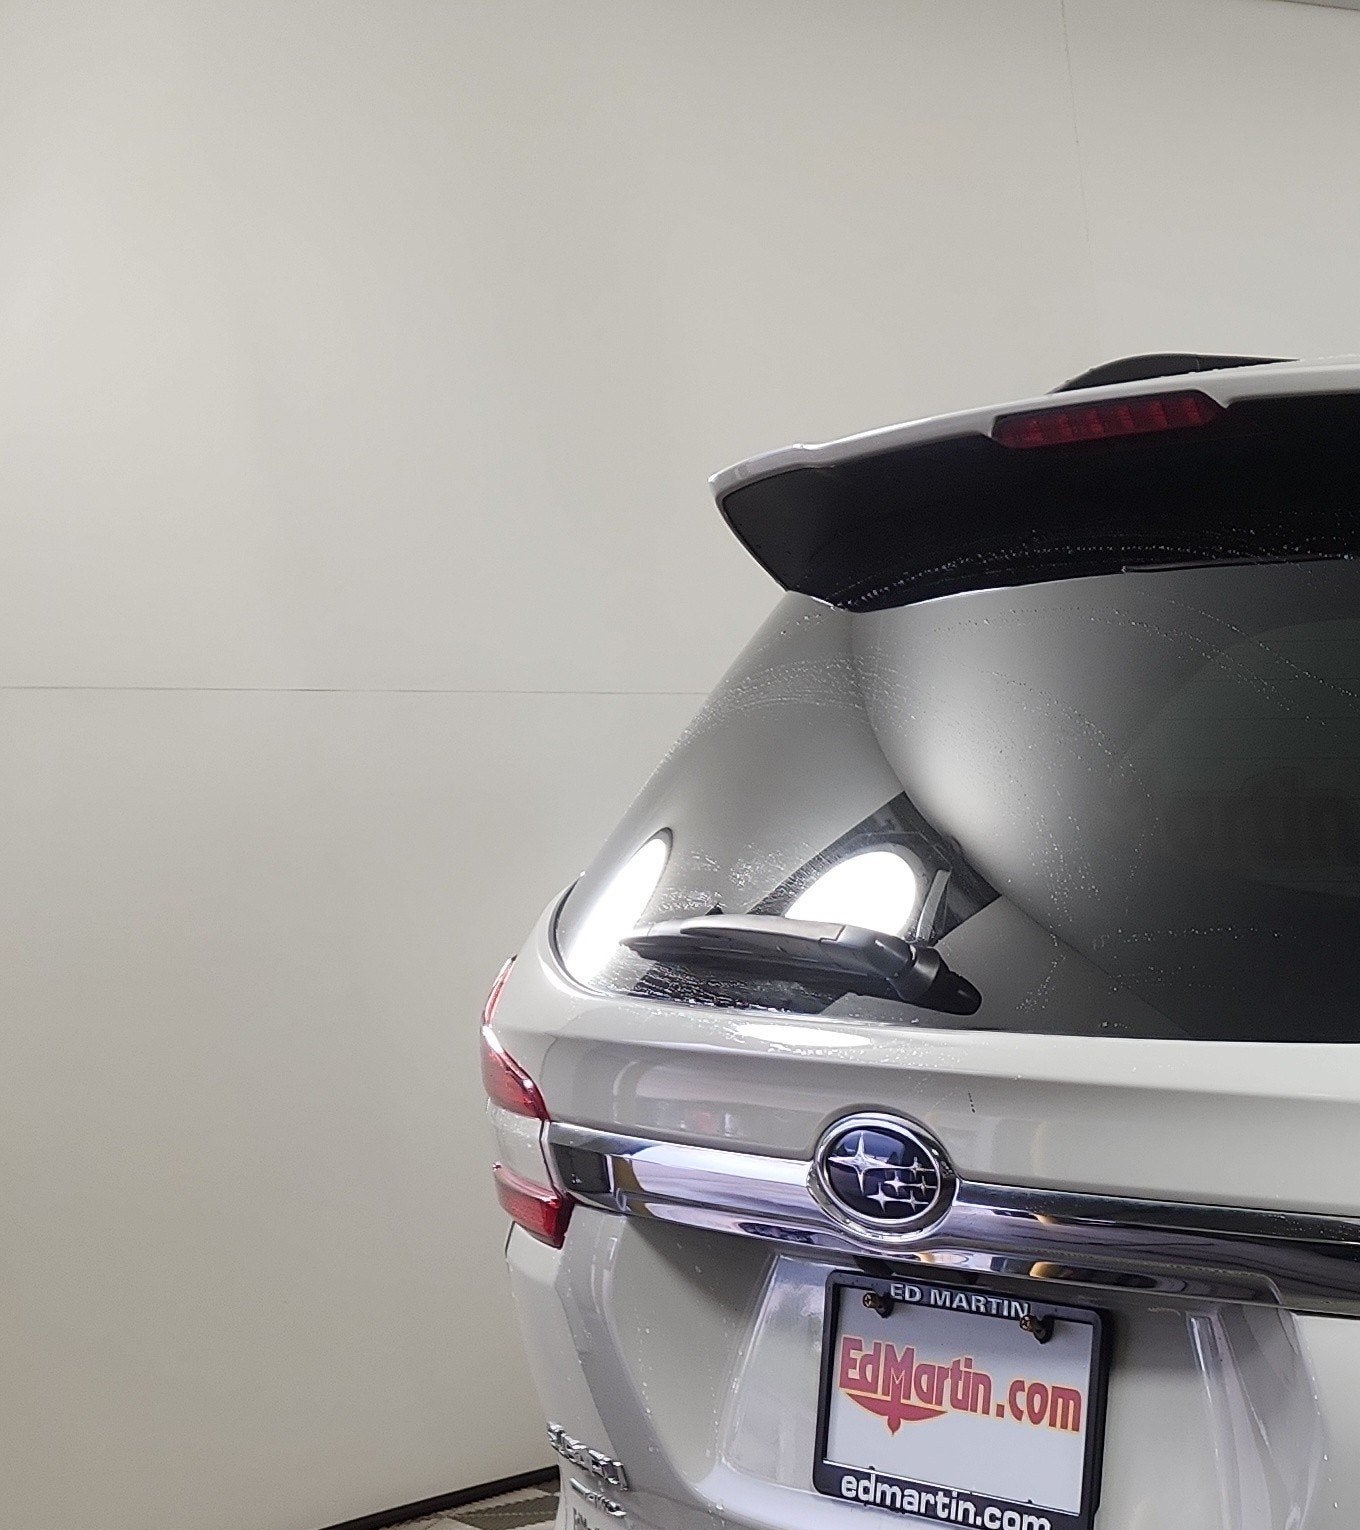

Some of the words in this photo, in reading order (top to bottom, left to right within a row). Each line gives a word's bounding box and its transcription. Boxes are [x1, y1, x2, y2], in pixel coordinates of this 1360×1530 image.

[890, 1283, 922, 1302] ED
[930, 1289, 1030, 1318] MARTIN
[838, 1334, 1083, 1433] EdMartin.com
